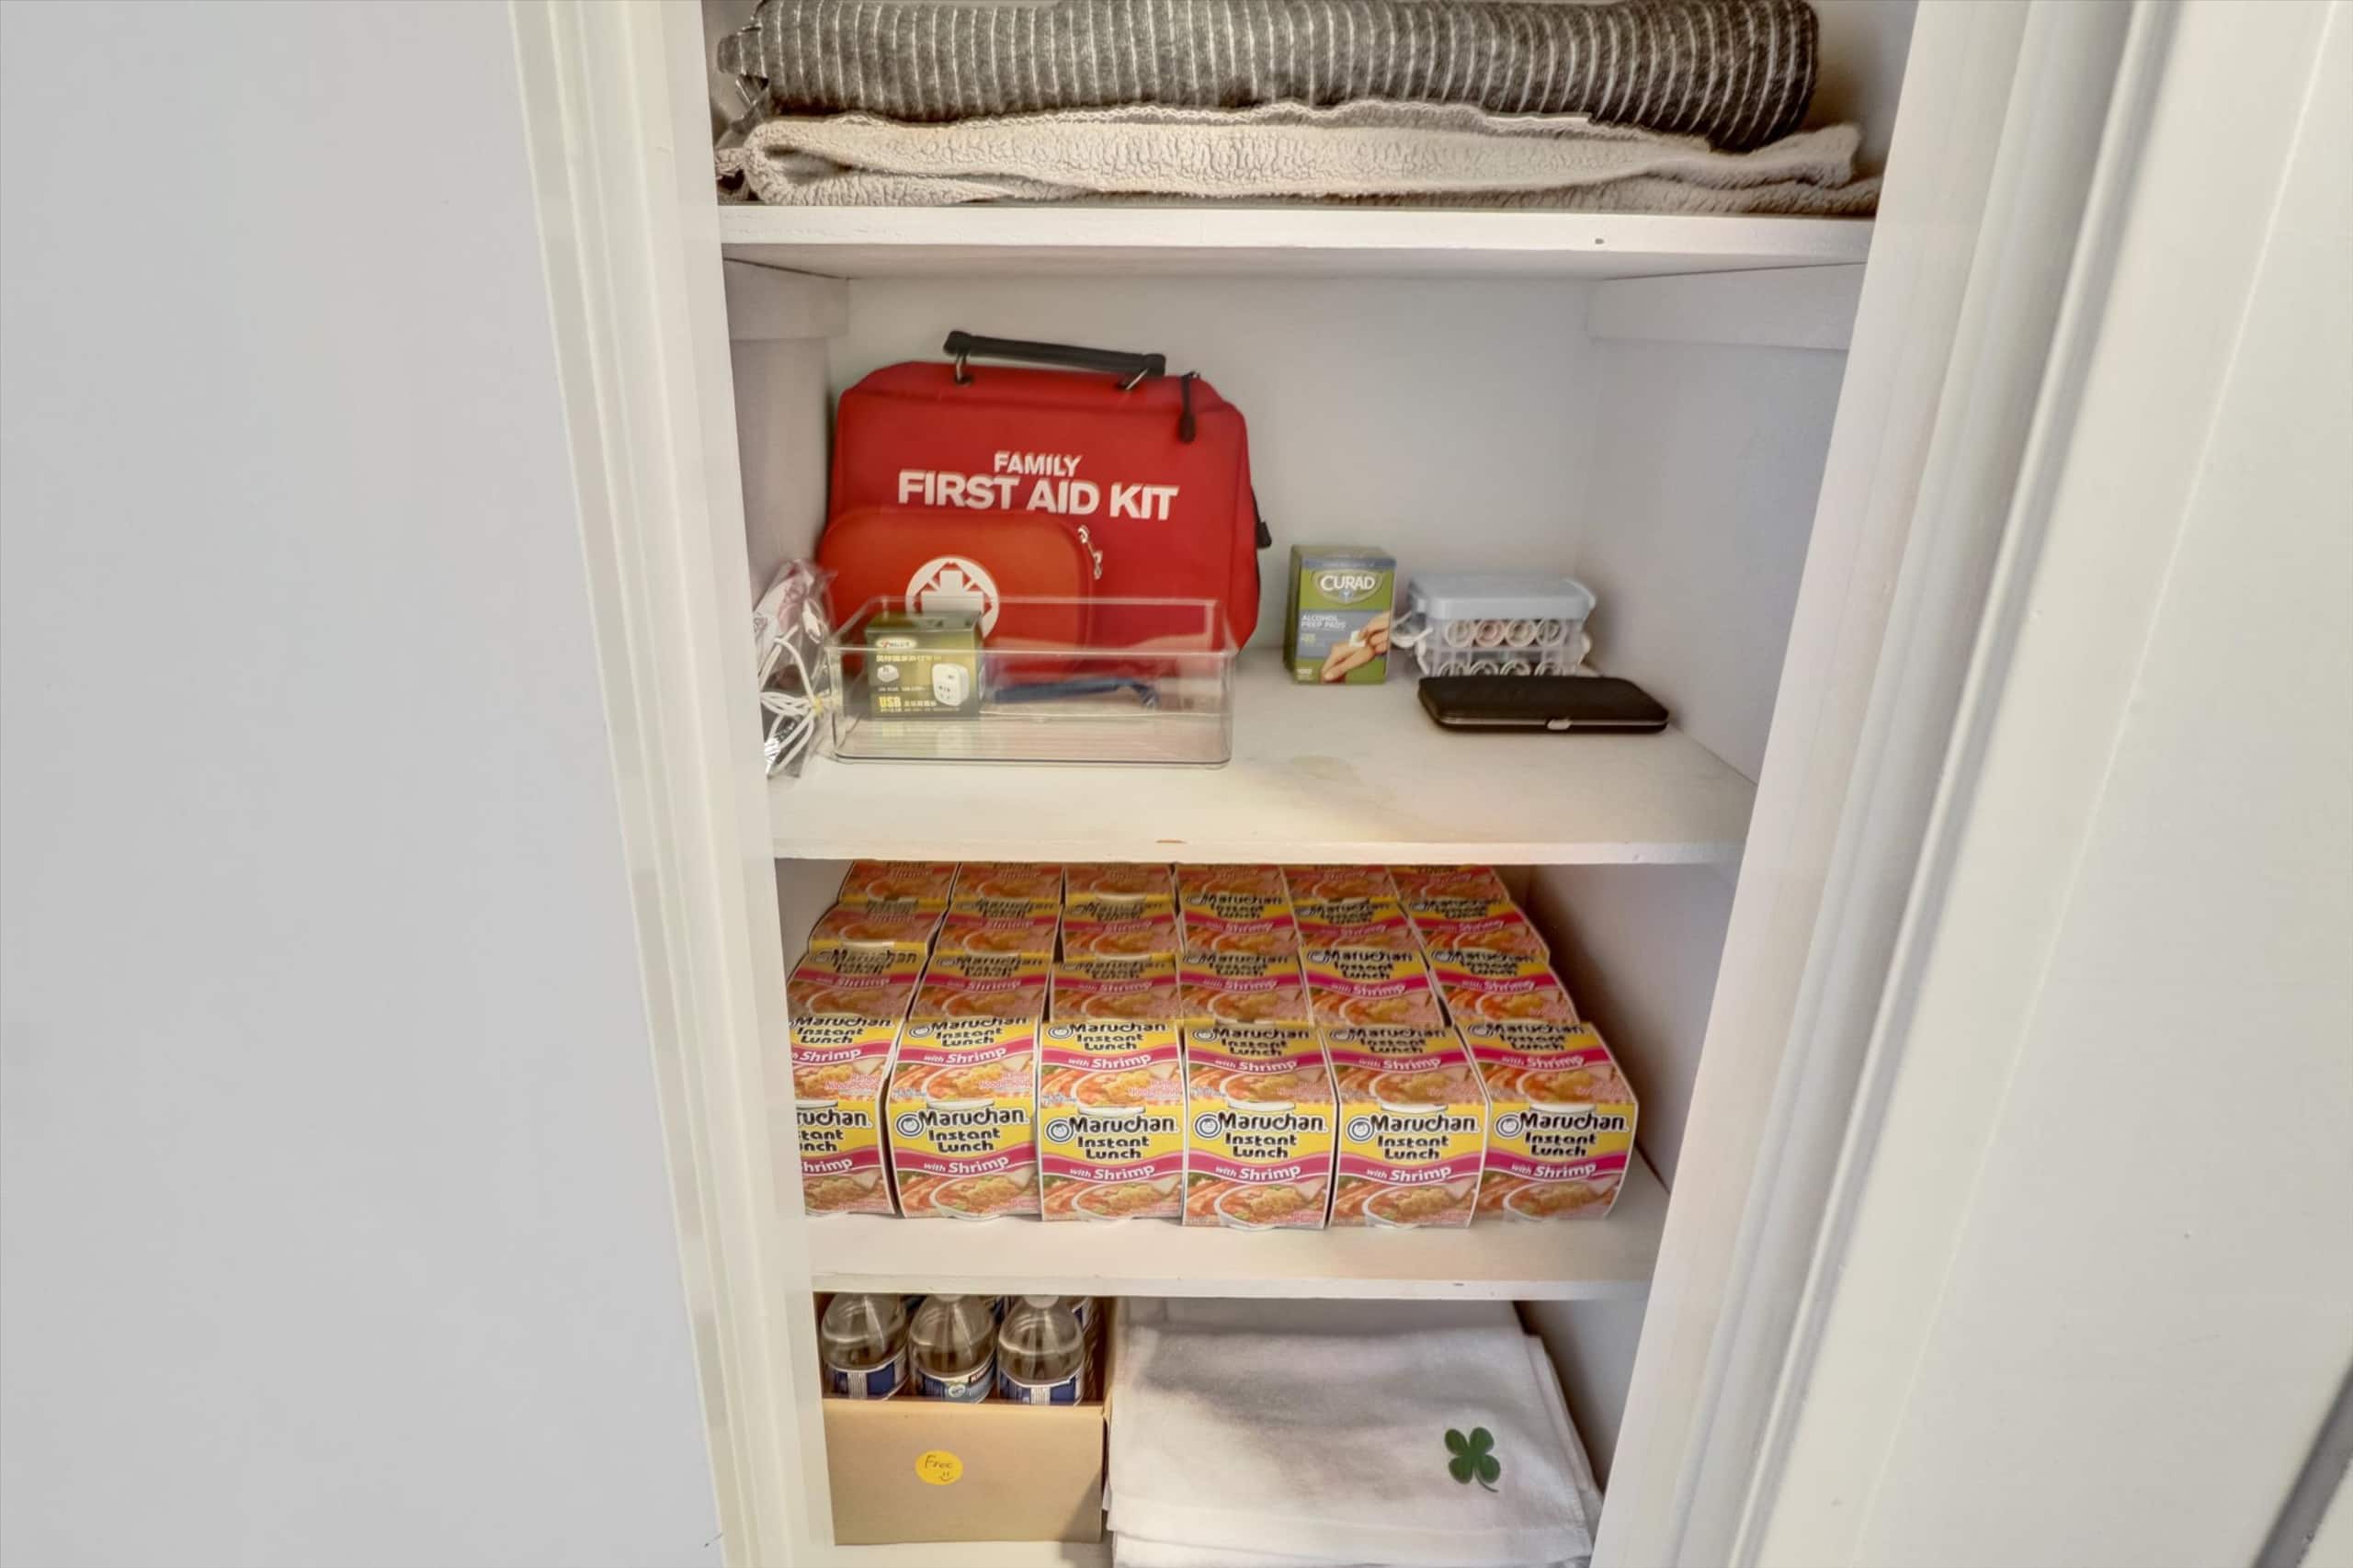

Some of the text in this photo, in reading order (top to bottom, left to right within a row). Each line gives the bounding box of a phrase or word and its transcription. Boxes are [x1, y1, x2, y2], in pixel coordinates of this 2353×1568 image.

[994, 451, 1082, 477] FAMILY
[898, 470, 1179, 520] FIRST AID KIT
[1320, 574, 1375, 591] CURAD
[879, 696, 901, 708] USB
[1324, 950, 1413, 961] Maruchan
[796, 1016, 892, 1027] Maruchan
[931, 1016, 1027, 1030] Maruchan
[1069, 1022, 1166, 1034] Maruchan
[798, 1028, 864, 1036] Instant
[936, 1028, 1003, 1040] Instant
[1214, 1027, 1309, 1039] Maruchan
[1349, 1028, 1446, 1038] Maruchan
[1486, 1023, 1584, 1035] Maruchan
[942, 1036, 995, 1047] Lunch
[1077, 1033, 1143, 1042] Instant
[1222, 1039, 1288, 1049] Instant
[1085, 1041, 1137, 1051] Lunch
[1230, 1047, 1282, 1056] Lunch
[799, 1049, 862, 1062] Shrimp
[923, 1047, 1006, 1064] with Shrimp
[1068, 1053, 1152, 1070] with Shrimp
[1527, 1055, 1585, 1069] Shrimp
[1215, 1059, 1297, 1072] with Shrimp
[1383, 1057, 1441, 1071] Shrimp
[918, 1108, 1025, 1126] Maruchan
[1218, 1112, 1324, 1131] Maruchan
[1370, 1114, 1475, 1132] Maruchan
[1520, 1112, 1624, 1131] Maruchan
[1069, 1116, 1175, 1133] Maruchan
[798, 1130, 844, 1141] tant
[928, 1128, 1000, 1142] Instant
[1225, 1132, 1297, 1146] Instant
[1525, 1132, 1596, 1145] Instant
[938, 1141, 994, 1153] Lunch
[1078, 1136, 1149, 1148] Instant
[1378, 1136, 1449, 1148] Instant
[1086, 1149, 1141, 1159] Lunch
[1233, 1147, 1288, 1158] Lunch
[1384, 1149, 1439, 1160] Lunch
[1531, 1146, 1586, 1157] Lunch
[801, 1158, 853, 1173] hrimp
[924, 1156, 1009, 1174] with Shrimp
[1511, 1163, 1597, 1178] with Shrimp
[1069, 1165, 1155, 1181] with Shrimp
[1215, 1165, 1301, 1181] with Shrimp
[1366, 1166, 1451, 1182] with Shrimp
[924, 1454, 953, 1470] Free
